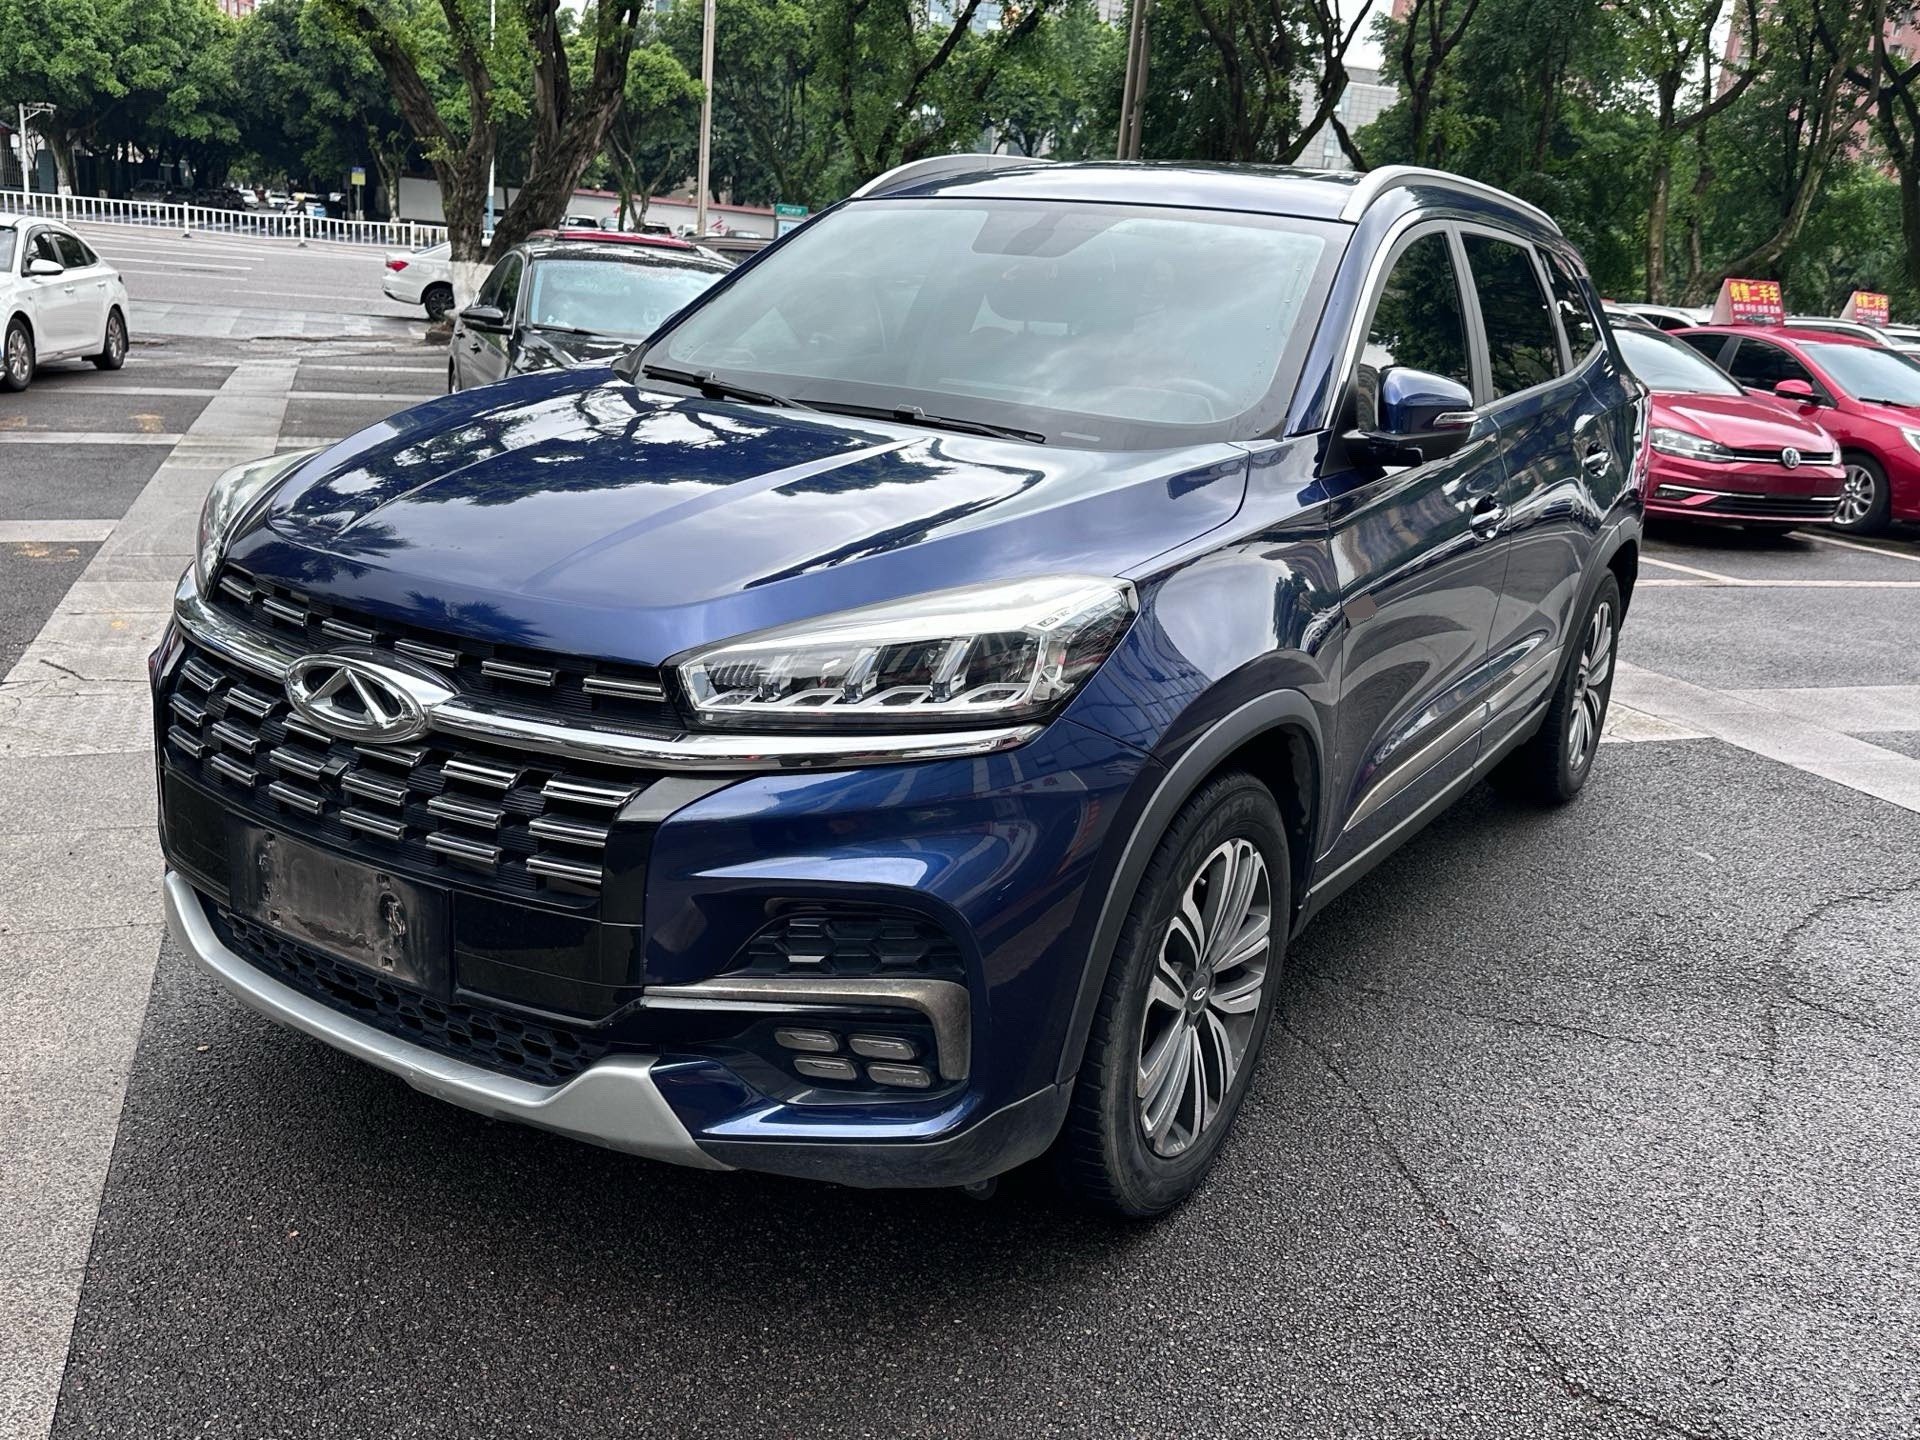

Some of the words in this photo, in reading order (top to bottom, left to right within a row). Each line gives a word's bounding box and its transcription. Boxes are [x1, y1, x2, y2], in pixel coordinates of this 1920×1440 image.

[1730, 282, 1779, 304] 收售二手车
